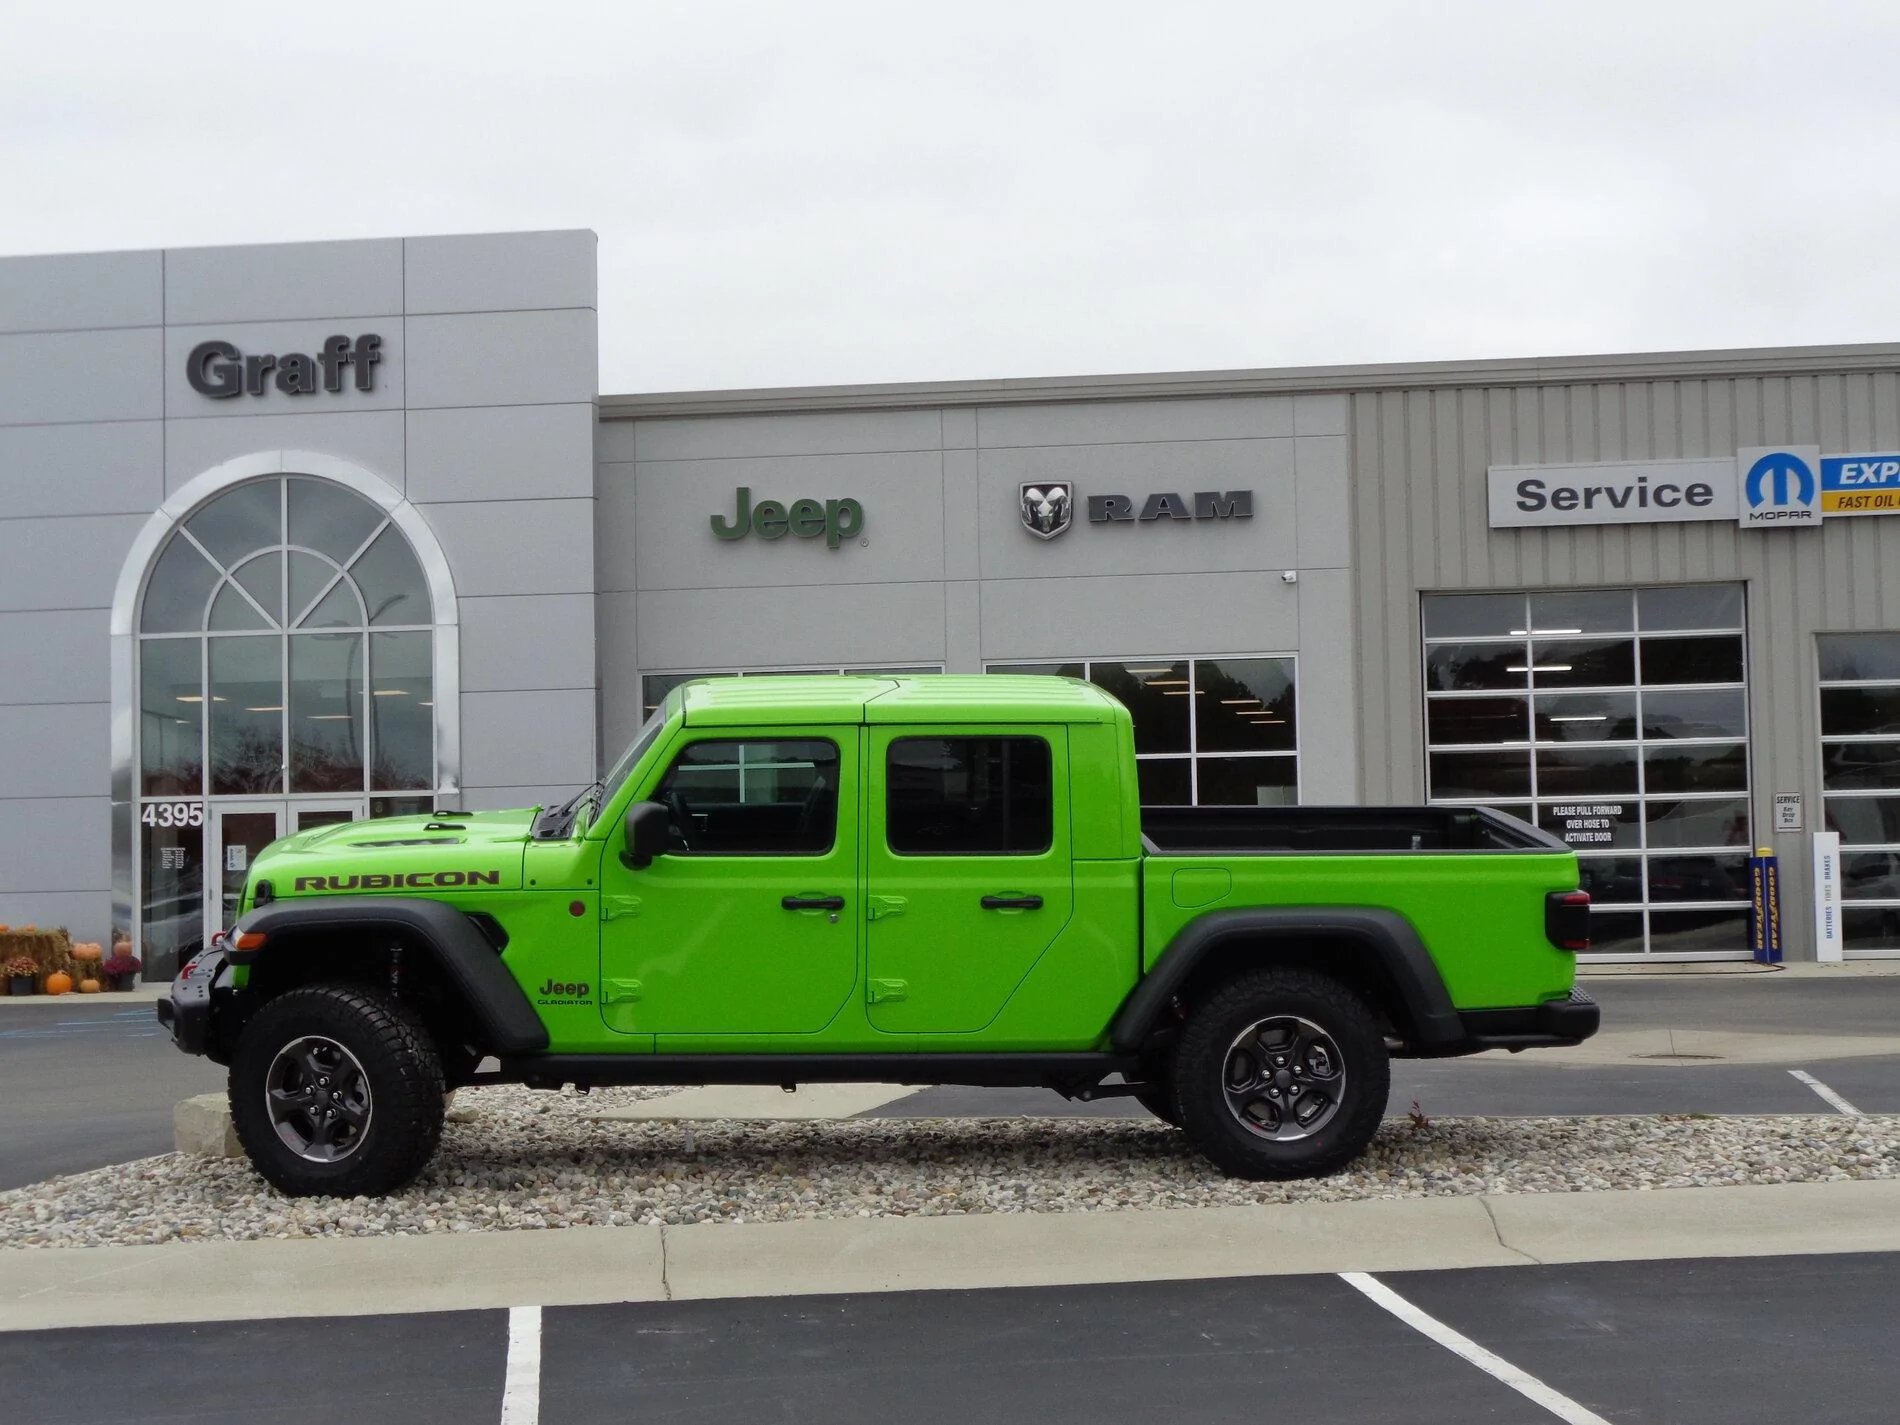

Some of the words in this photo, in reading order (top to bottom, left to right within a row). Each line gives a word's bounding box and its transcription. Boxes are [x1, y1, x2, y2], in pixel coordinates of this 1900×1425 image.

[187, 334, 382, 399] Graff
[1839, 462, 1900, 484] EXP
[1516, 476, 1714, 512] Service
[1838, 496, 1871, 509] FAST
[1874, 495, 1894, 507] OIL
[1087, 490, 1254, 522] RAM
[1749, 510, 1812, 521] MOPAR
[710, 487, 865, 549] Jeep
[142, 803, 204, 827] 4395
[1553, 806, 1576, 815] PLEASE
[1577, 806, 1592, 815] PULL
[1593, 806, 1622, 814] FORWARD
[1566, 820, 1582, 828] OVER
[1584, 820, 1600, 828] HOSE
[1601, 820, 1609, 828] TO
[1565, 833, 1594, 841] ACTIVATE
[1595, 833, 1612, 841] DOOR
[294, 870, 500, 891] RUBICON
[1755, 867, 1764, 949] GOODYEAR
[1769, 866, 1778, 949] GOODYEAR
[539, 979, 590, 997] Jeep
